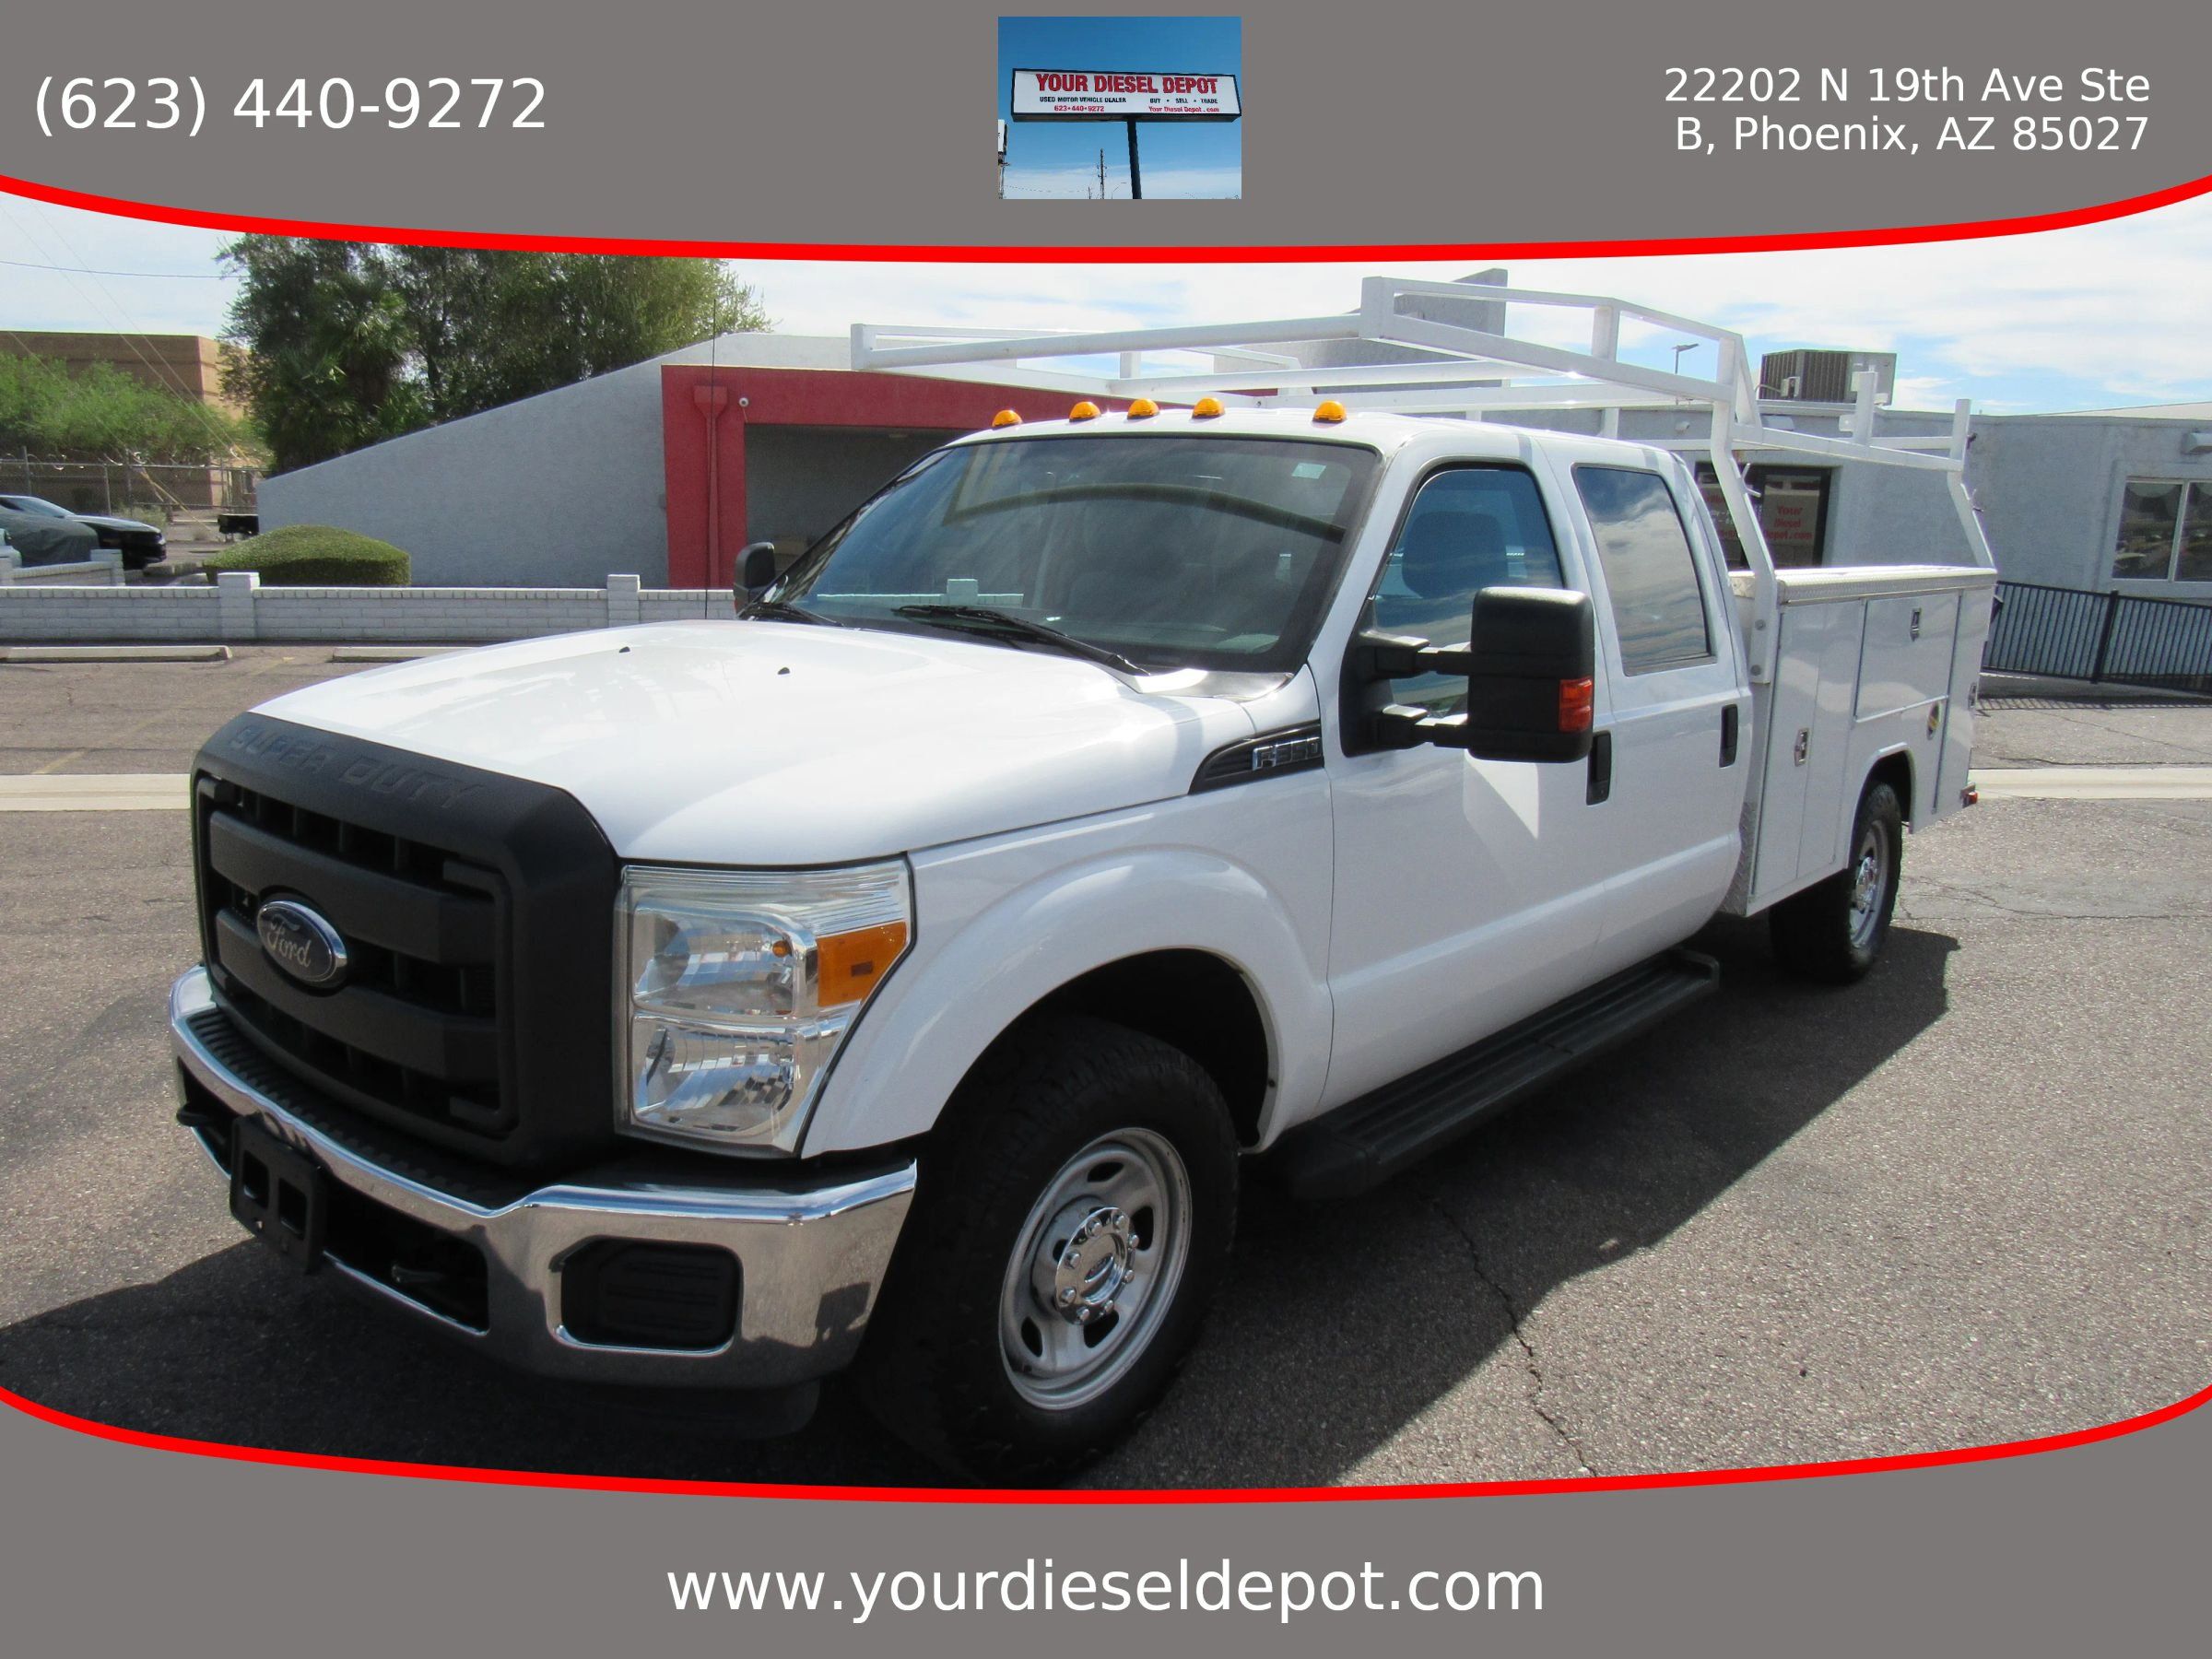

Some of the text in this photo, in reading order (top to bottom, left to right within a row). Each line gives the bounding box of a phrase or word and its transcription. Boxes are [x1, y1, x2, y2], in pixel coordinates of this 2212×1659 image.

[229, 724, 488, 809] SUPER DUTY
[266, 913, 312, 968] Ford
